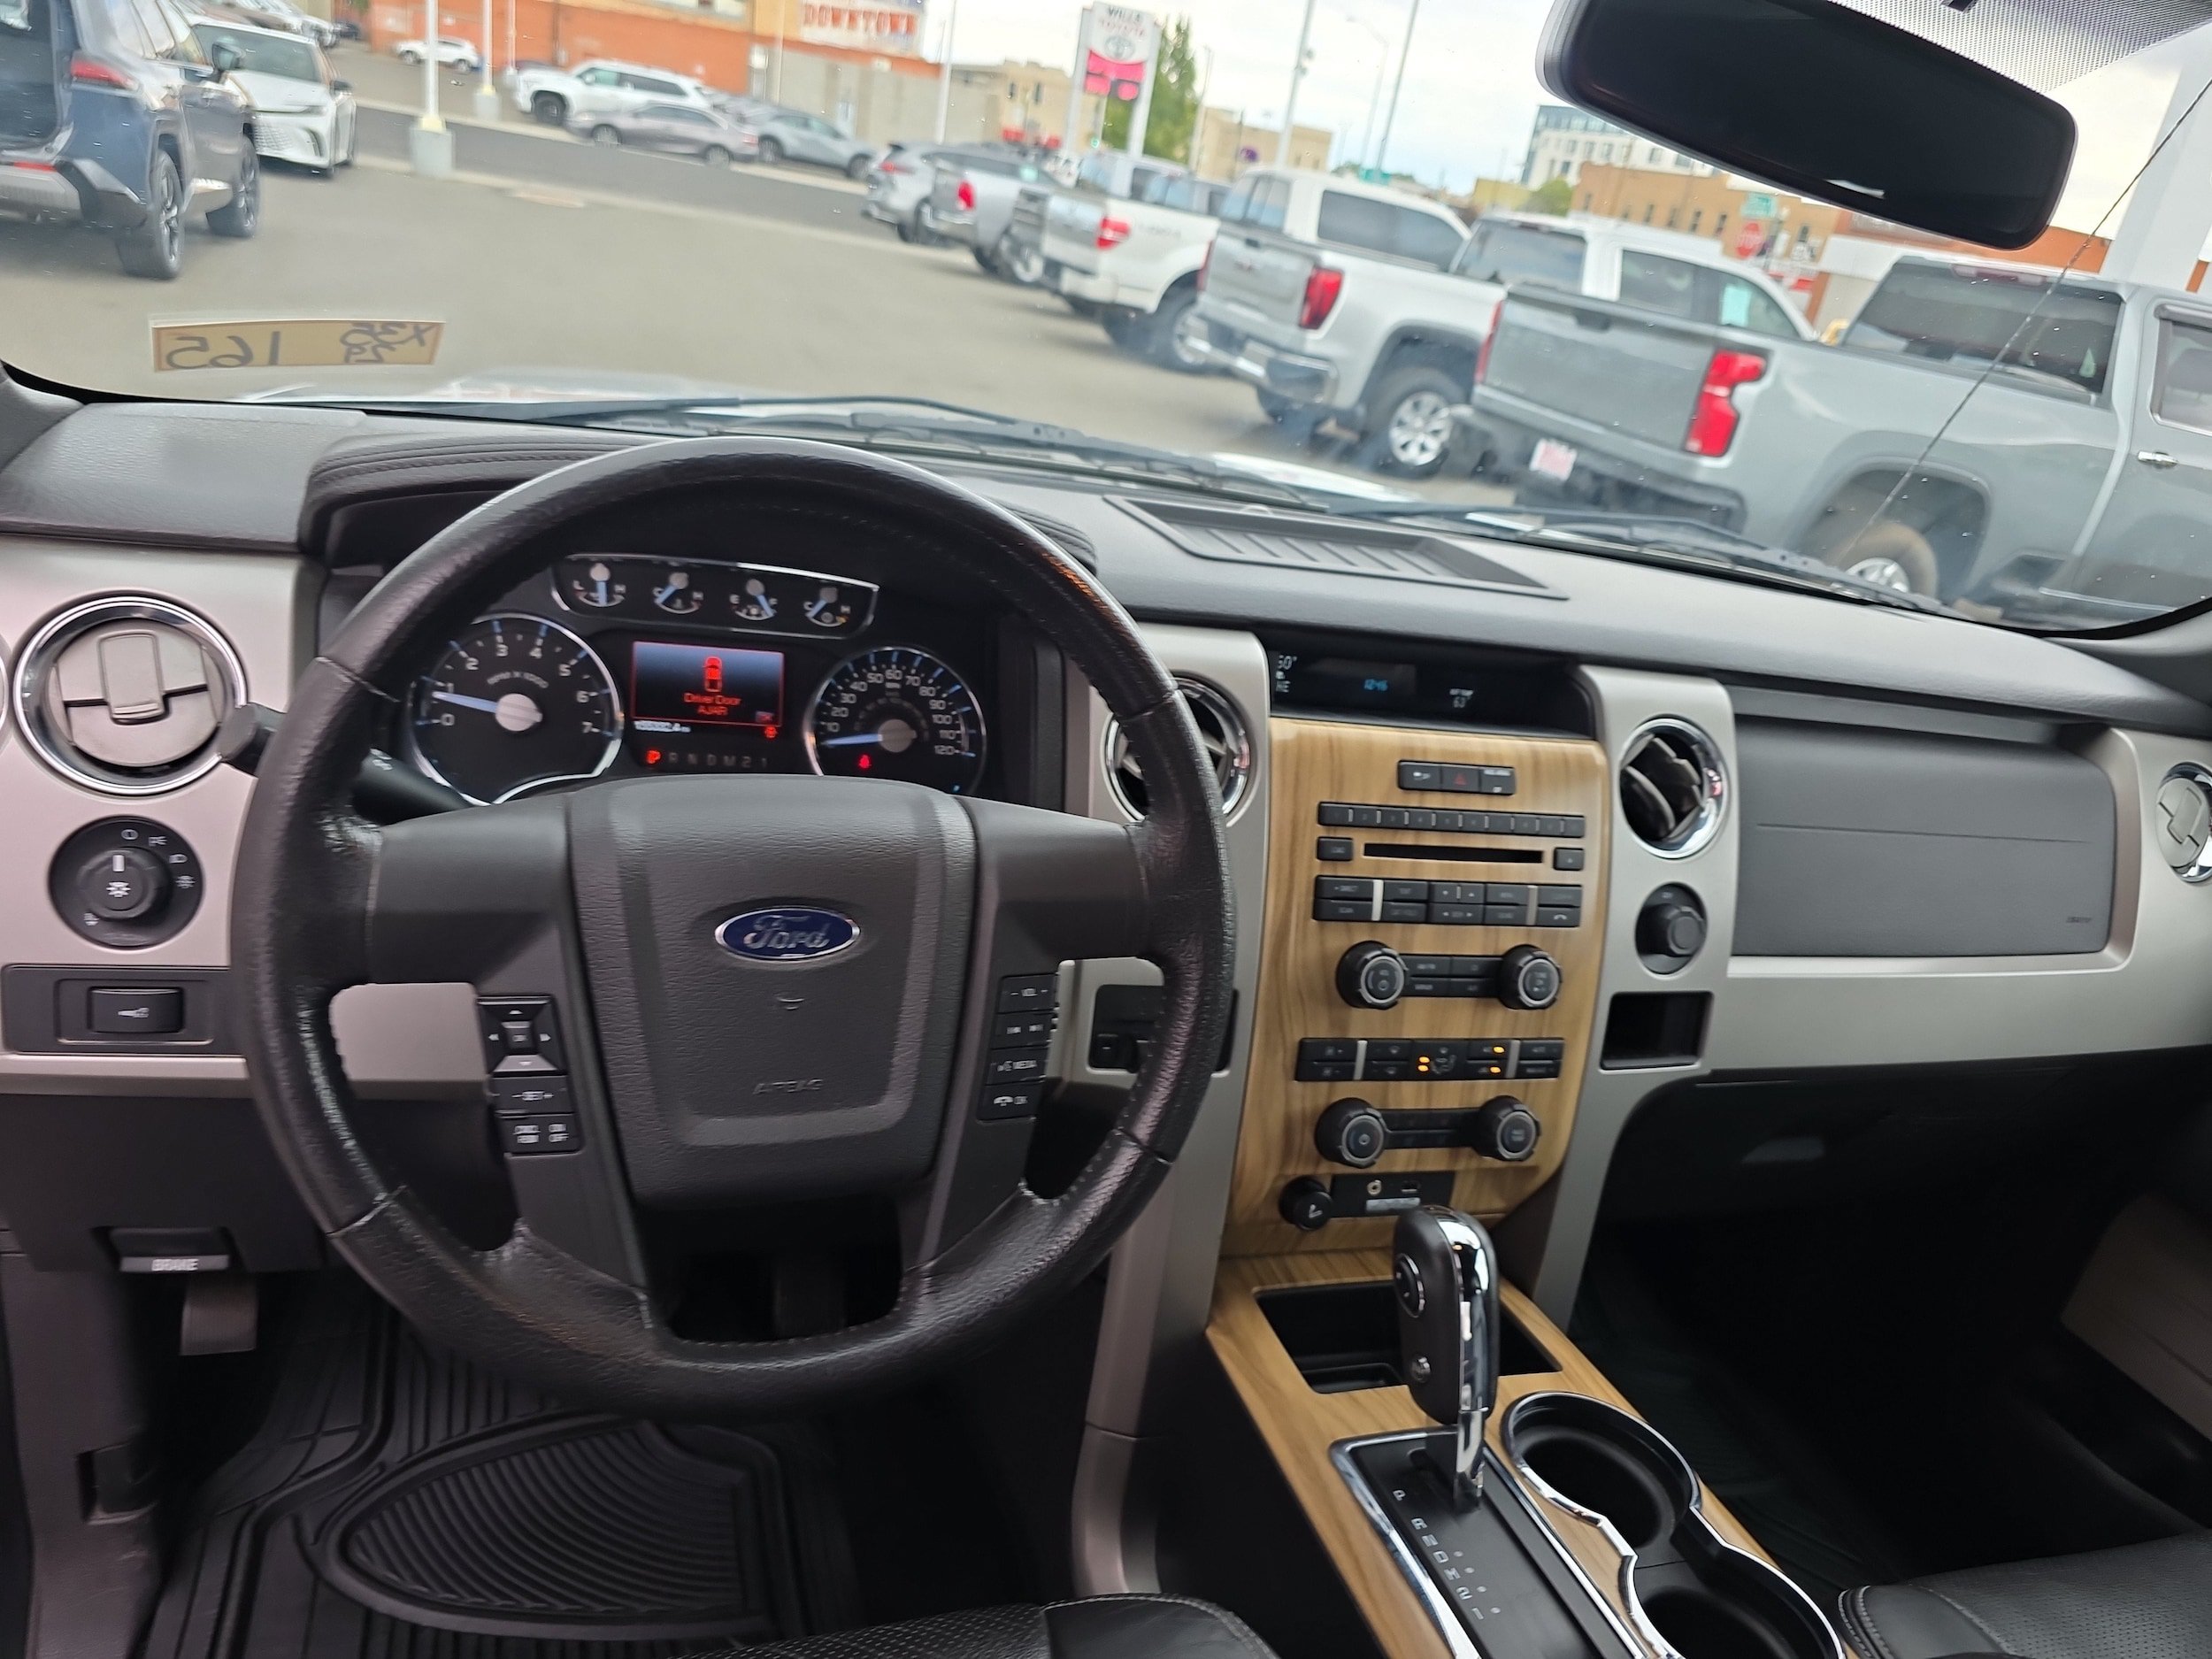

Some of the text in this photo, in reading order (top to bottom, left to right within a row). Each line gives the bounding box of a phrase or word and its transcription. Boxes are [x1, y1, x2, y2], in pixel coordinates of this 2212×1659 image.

[495, 643, 509, 657] 3
[529, 645, 542, 659] 4
[465, 657, 479, 671] 2
[558, 664, 572, 677] 5
[885, 669, 902, 680] 60
[866, 672, 884, 684] 50
[905, 675, 921, 687] 70
[849, 681, 868, 692] 40
[918, 686, 936, 697] 80
[576, 690, 589, 703] 6
[841, 693, 856, 703] 30
[929, 699, 947, 710] 90
[831, 707, 849, 718] 20
[932, 714, 952, 725] 100
[581, 721, 594, 733] 7
[933, 745, 956, 755] 120
[743, 915, 830, 949] Ford
[151, 1258, 199, 1271] BRAKE
[1392, 1489, 1406, 1501] P
[1411, 1517, 1427, 1530] R
[1432, 1551, 1448, 1563] D
[1456, 1586, 1472, 1600] 2
